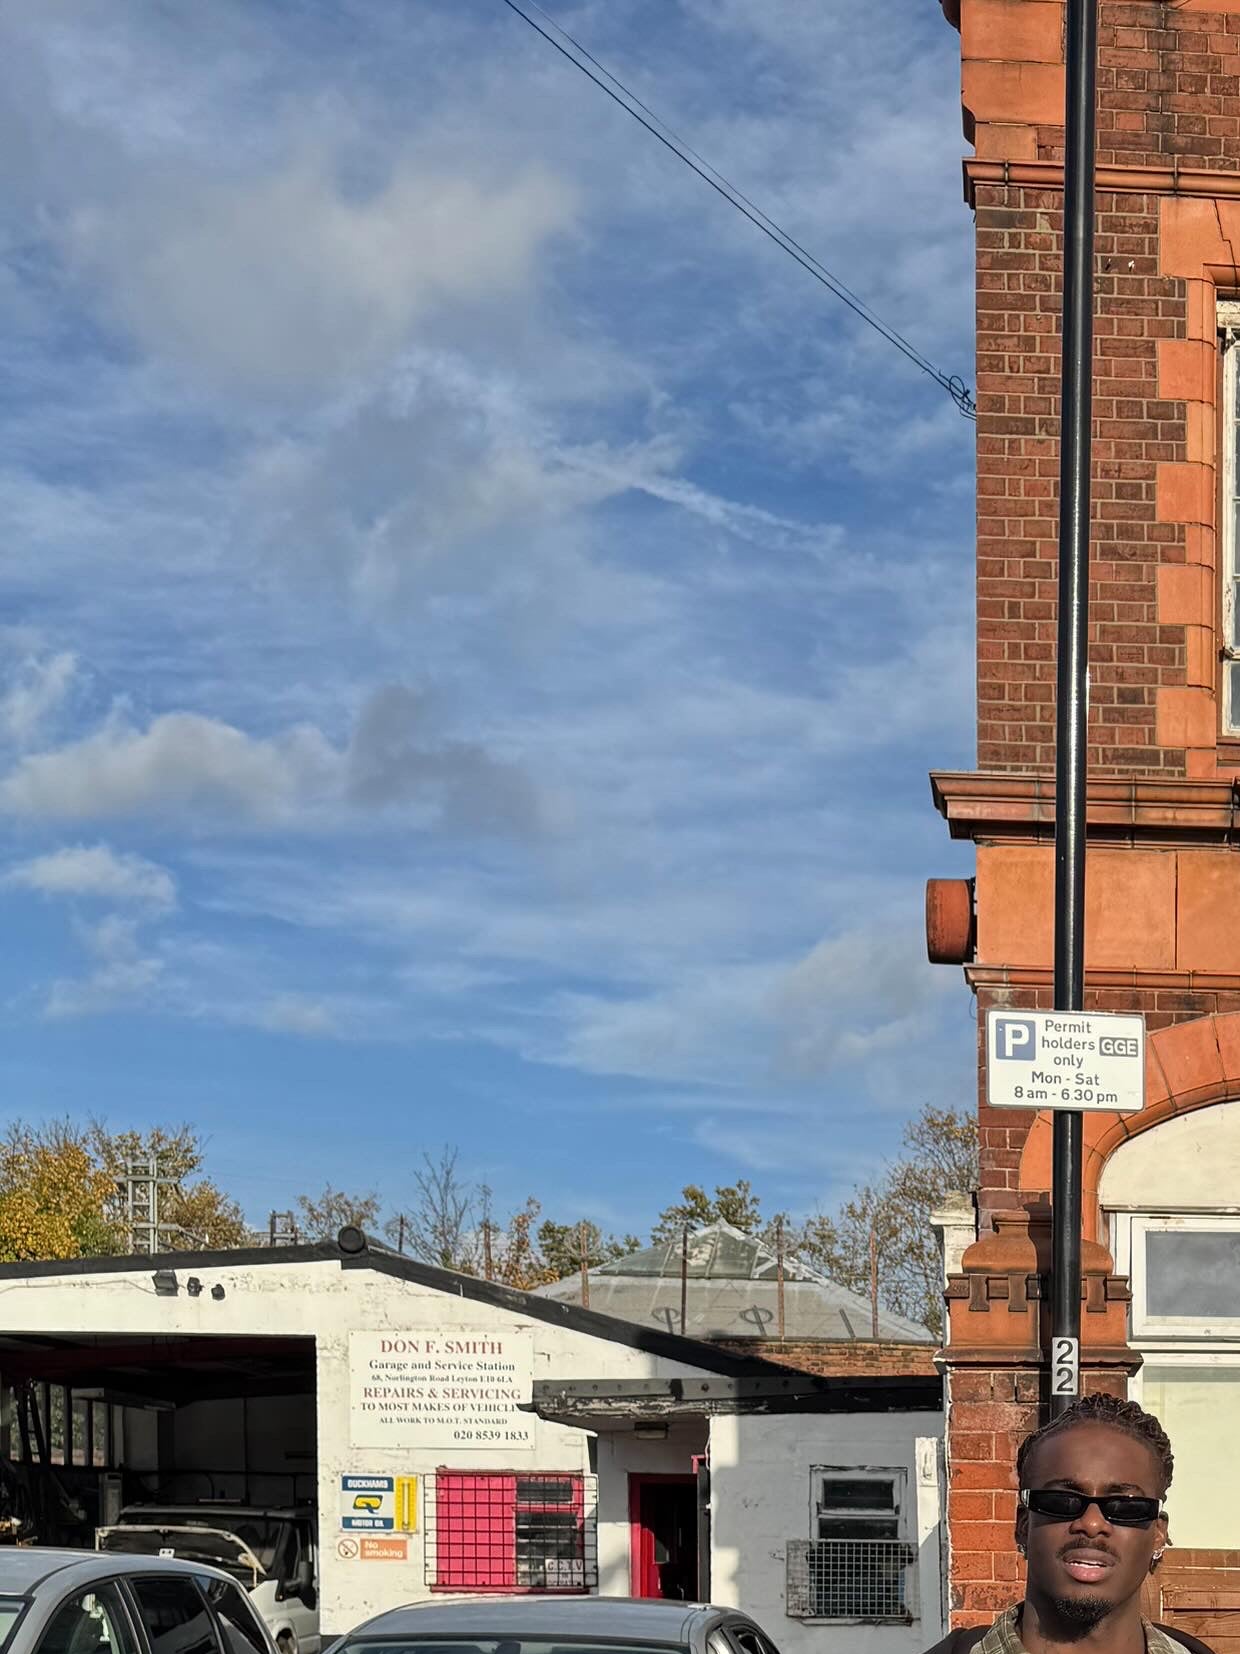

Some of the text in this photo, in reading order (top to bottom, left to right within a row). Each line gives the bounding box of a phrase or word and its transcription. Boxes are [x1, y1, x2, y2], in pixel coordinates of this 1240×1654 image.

[1045, 1020, 1092, 1034] Permit
[1004, 1023, 1030, 1057] P
[1042, 1036, 1096, 1050] holders
[1100, 1039, 1138, 1056] GGE
[1053, 1054, 1084, 1068] only
[1031, 1071, 1062, 1084] Mon
[1074, 1073, 1100, 1086] Sat
[1061, 1089, 1094, 1101] 6.30
[381, 1340, 503, 1354] DON F. SMITH
[369, 1359, 515, 1371] Garage and Service Station
[363, 1387, 521, 1400] REPAIRS & SERVICING
[361, 1402, 376, 1411] TO
[378, 1402, 410, 1411] MOST
[412, 1403, 450, 1411] MAKES
[453, 1403, 469, 1411] OF
[453, 1430, 529, 1441] 020 8539 1833
[351, 1519, 373, 1527] MOTOR
[364, 1541, 378, 1549] No
[365, 1549, 404, 1558] smoking
